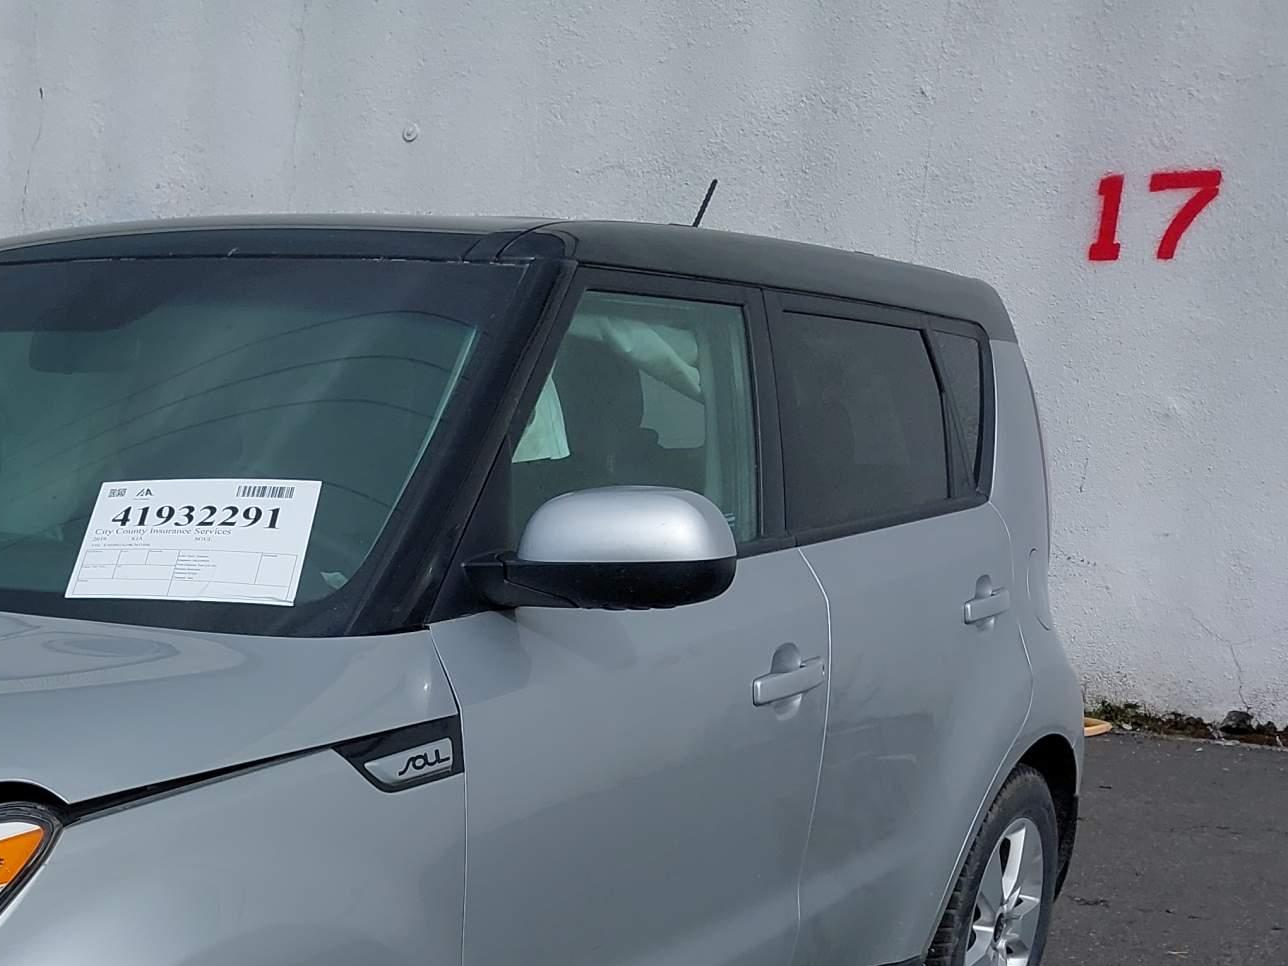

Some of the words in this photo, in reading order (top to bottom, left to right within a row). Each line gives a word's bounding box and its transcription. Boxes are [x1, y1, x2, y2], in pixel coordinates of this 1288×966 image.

[1088, 170, 1222, 261] 17
[111, 505, 281, 530] 41932291
[95, 528, 113, 536] City
[116, 527, 147, 536] County
[150, 527, 191, 535] Insurance
[194, 527, 232, 535] Services
[398, 749, 450, 776] SOUL
